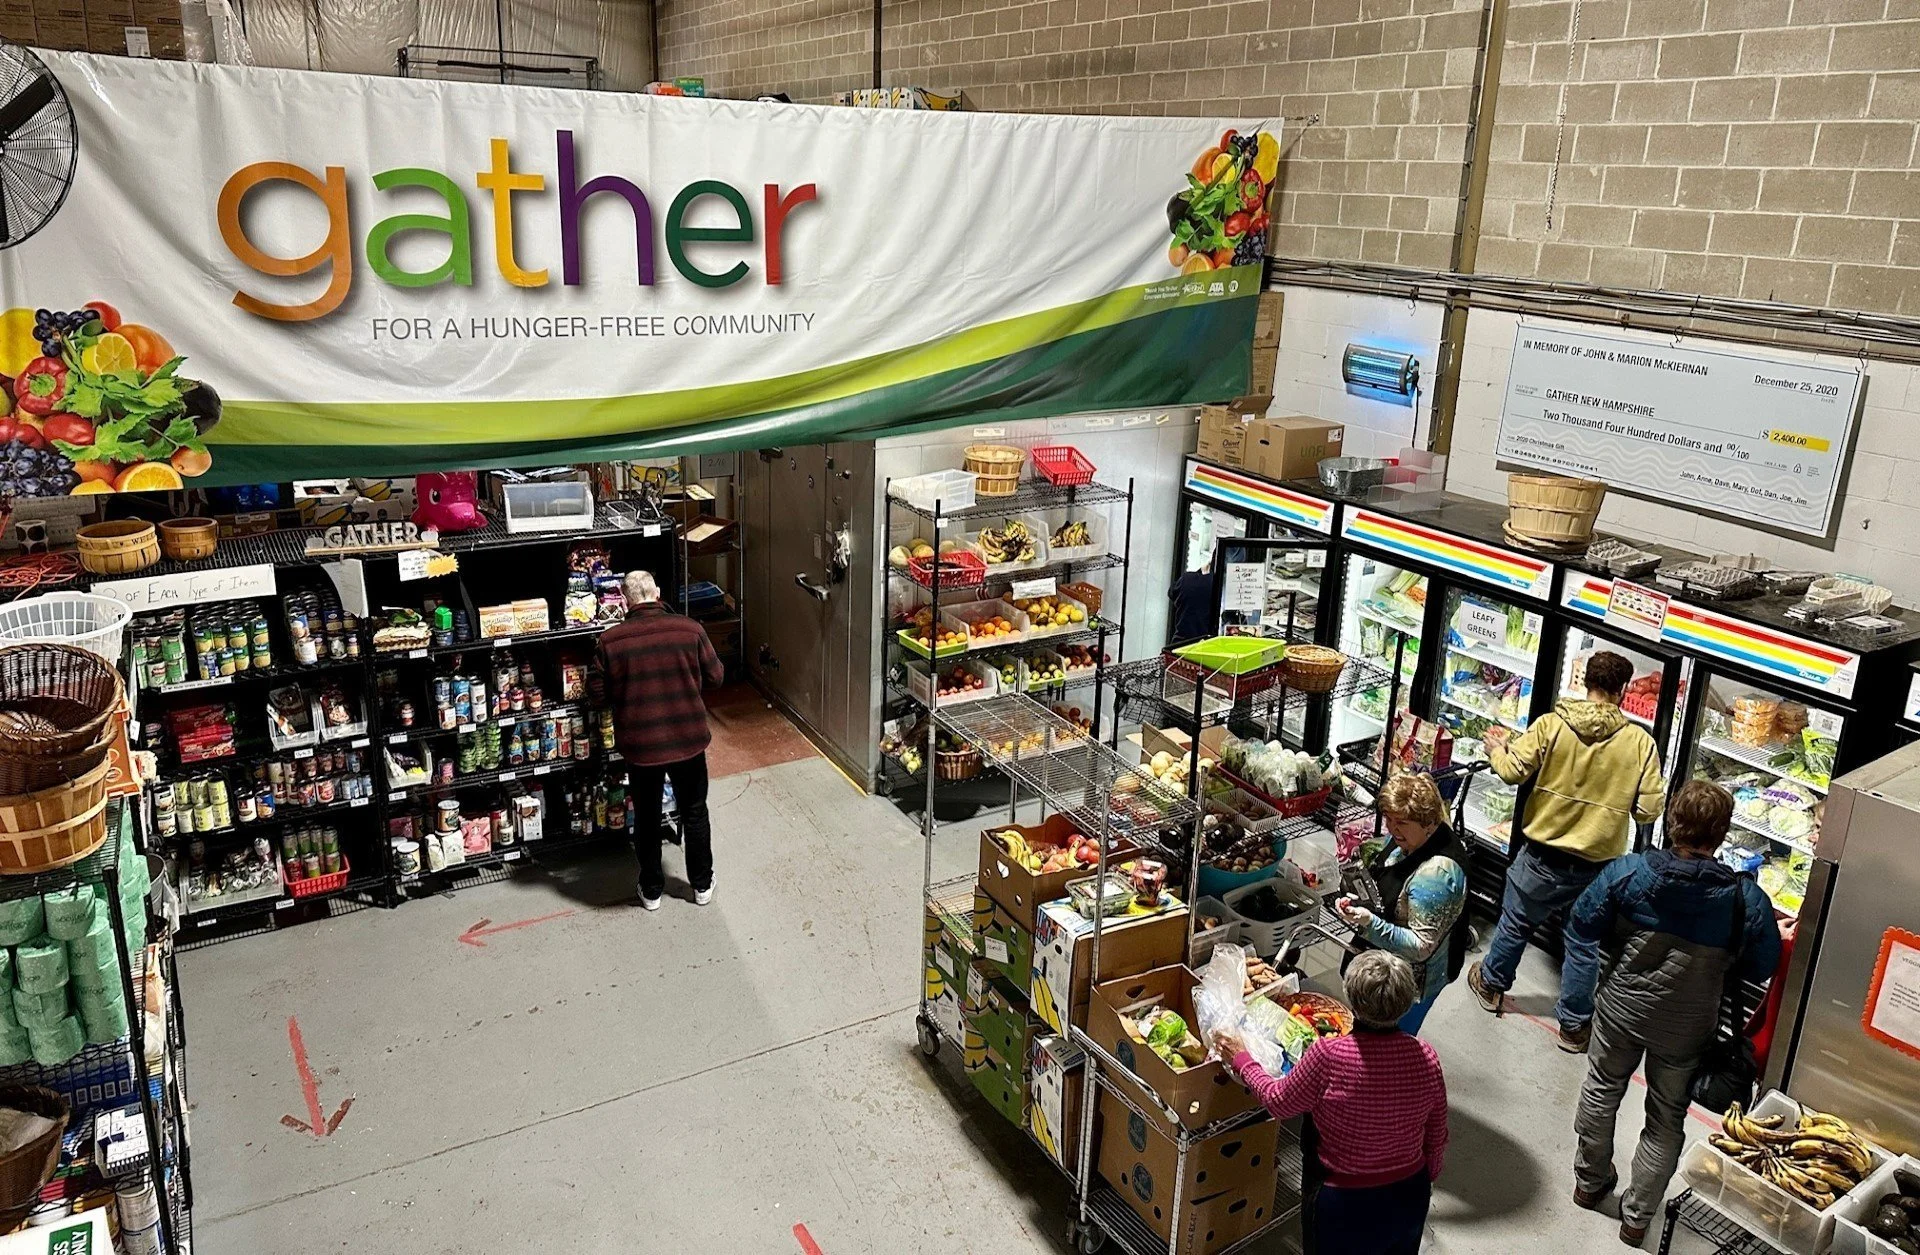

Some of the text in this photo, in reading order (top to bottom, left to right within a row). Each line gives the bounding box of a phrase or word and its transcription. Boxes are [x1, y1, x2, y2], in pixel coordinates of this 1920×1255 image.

[217, 130, 816, 321] gather
[372, 312, 815, 340] FOR A HUNGER-FREE COMMUNITY
[1523, 339, 1709, 376] IN MEMORY OF JOHN & MARION McKIERNAN
[1754, 375, 1839, 396] December 25, 2020
[1546, 388, 1579, 404] GATHER
[1580, 395, 1600, 408] NEW
[1602, 399, 1655, 417] HAMPSHIRE
[1516, 435, 1529, 444] 2020
[1528, 437, 1554, 449] Christmas
[1555, 443, 1565, 451] Gift
[1543, 409, 1560, 421] Two
[1562, 413, 1604, 429] Thousand
[1605, 422, 1625, 434] Four
[1626, 426, 1666, 443] Hundred
[1667, 433, 1701, 449] Dollars
[1703, 441, 1723, 454] and
[1774, 433, 1807, 446] 2,400.00
[1794, 497, 1807, 505] Jim
[324, 521, 420, 548] GATHER
[184, 576, 208, 601] Type
[230, 575, 259, 590] Item
[1472, 610, 1495, 624] LEAFY
[1467, 623, 1497, 640] GREENS
